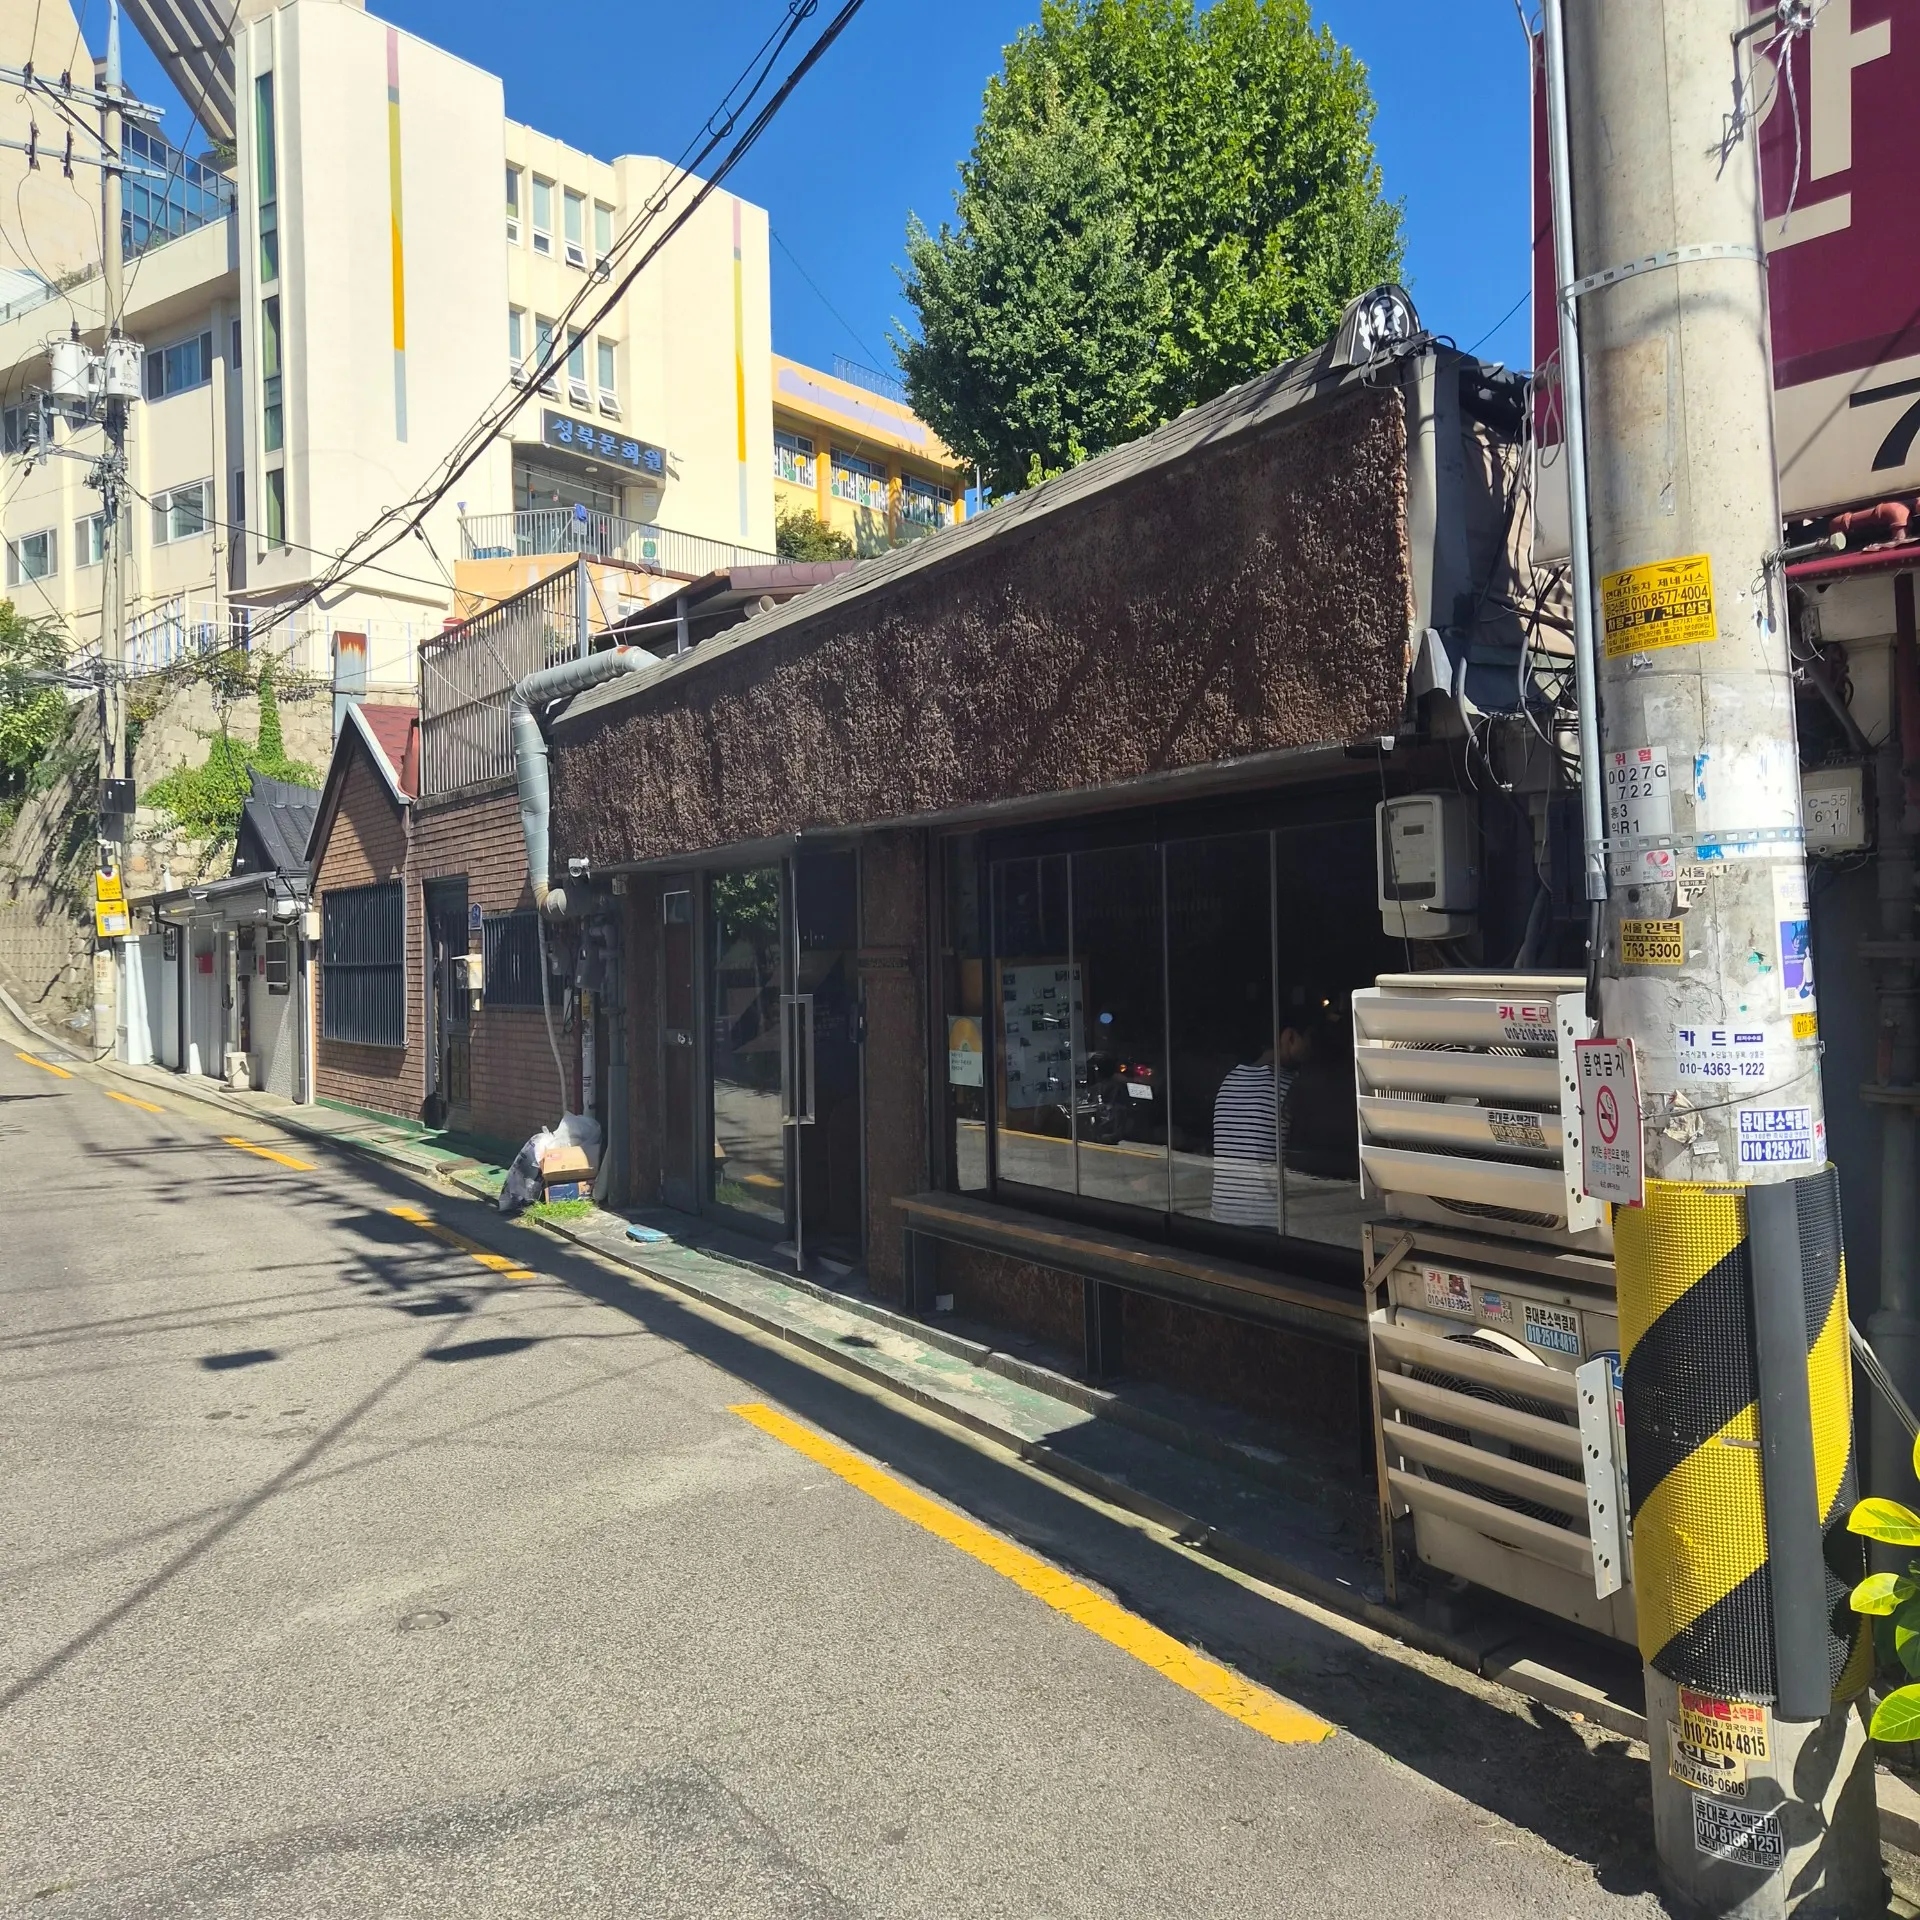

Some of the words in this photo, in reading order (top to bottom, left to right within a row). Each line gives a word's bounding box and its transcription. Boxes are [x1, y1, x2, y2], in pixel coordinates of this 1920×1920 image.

[552, 419, 662, 473] 성북문화원
[1606, 582, 1650, 600] 현대자동차
[1657, 573, 1704, 587] 제네시스
[1608, 611, 1645, 631] 차량구입
[1662, 601, 1708, 619] 견적상담
[1609, 764, 1666, 784] 0027G
[1619, 783, 1652, 800] 722
[1680, 867, 1704, 878] 서울
[1624, 923, 1642, 934] 서울
[1644, 922, 1680, 934] 인력
[1626, 943, 1680, 958] 763-5300
[1584, 1052, 1625, 1078] 흡연금지
[1680, 1062, 1764, 1076] 010-4363-1222
[1742, 1110, 1809, 1131] 휴대폰소액결제
[1526, 1306, 1576, 1333] 휴대폰소액결제
[1732, 1706, 1762, 1722] 소액결제
[1697, 1800, 1778, 1834] 휴대폰소액결제
